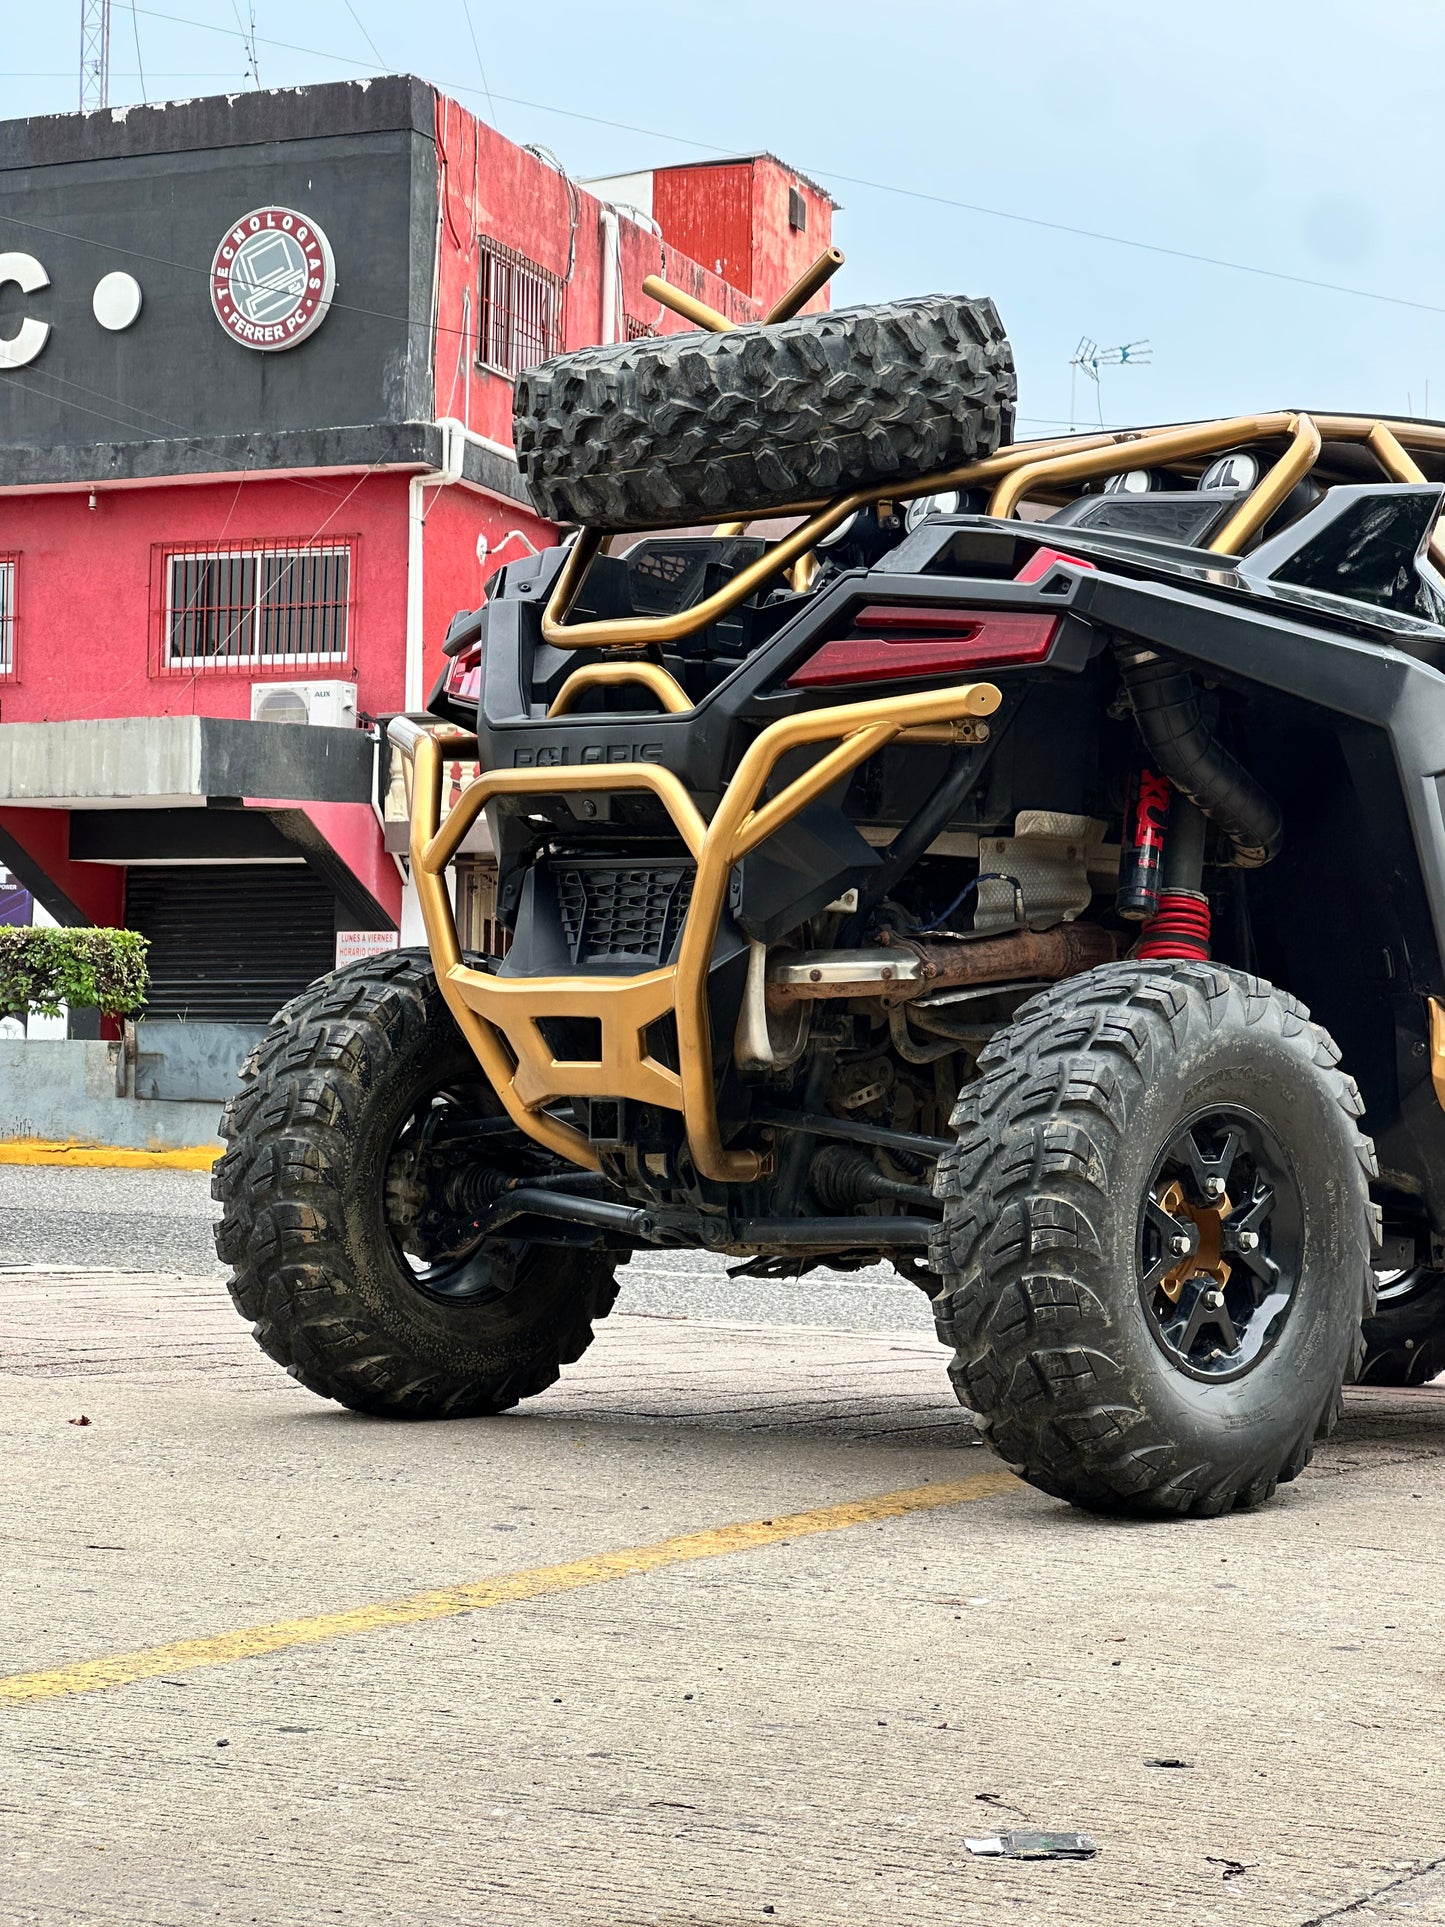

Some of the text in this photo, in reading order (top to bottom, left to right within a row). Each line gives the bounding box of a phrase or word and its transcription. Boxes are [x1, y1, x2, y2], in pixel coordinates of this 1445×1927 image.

[216, 213, 321, 300] TECNOLOGIAS
[228, 308, 307, 342] FERRER PC
[341, 934, 393, 943] LUNES A VIERNES
[340, 947, 366, 956] HORARIO
